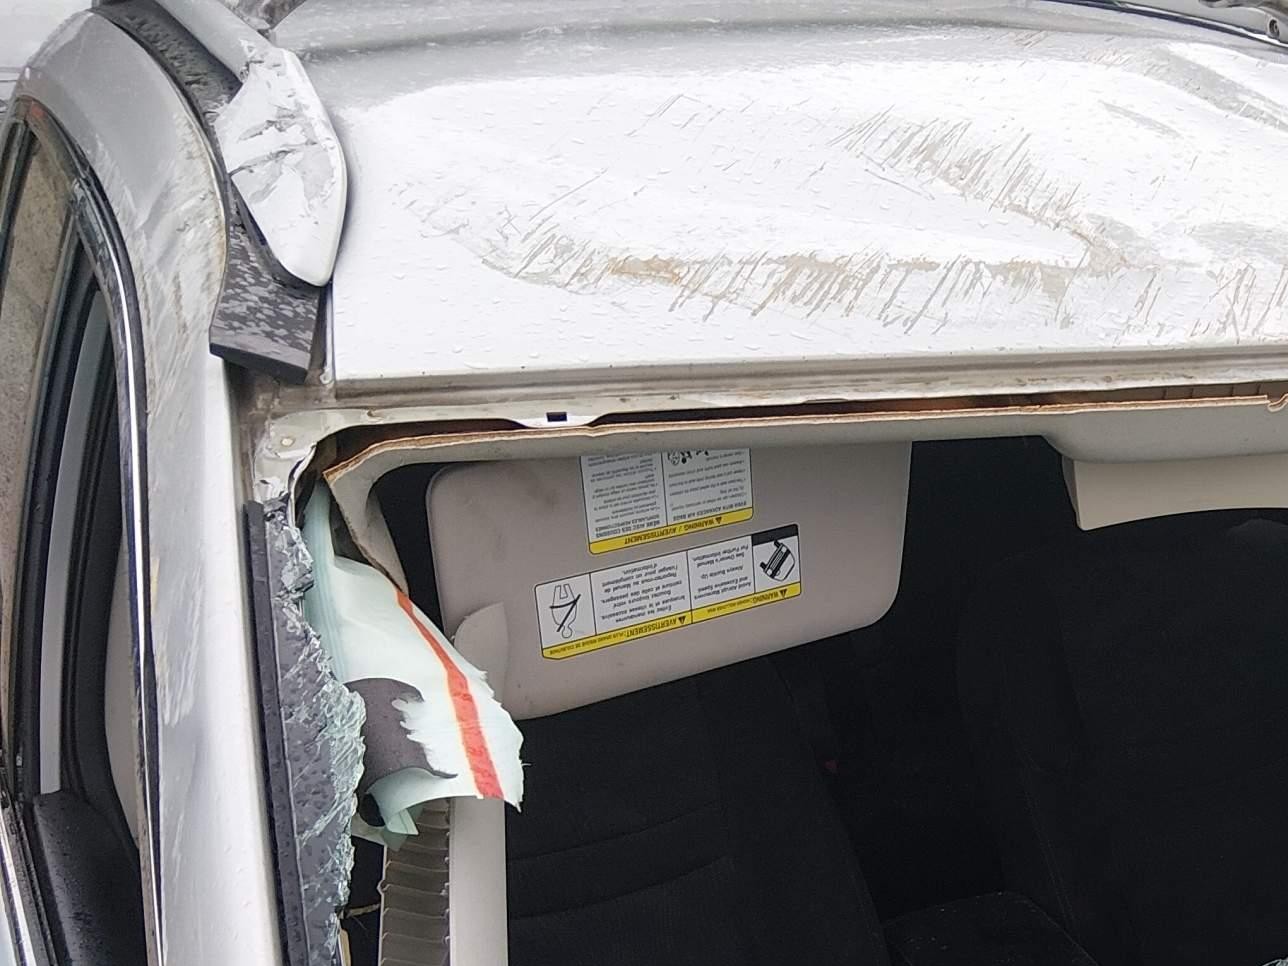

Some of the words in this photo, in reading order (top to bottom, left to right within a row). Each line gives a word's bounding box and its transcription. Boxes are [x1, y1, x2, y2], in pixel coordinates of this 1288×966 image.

[683, 518, 714, 531] WARNING
[623, 526, 676, 544] AVERTISSEMENT
[715, 554, 734, 563] Owner's
[696, 559, 714, 568] Manual
[726, 564, 743, 573] Always
[612, 582, 631, 592] Manuel
